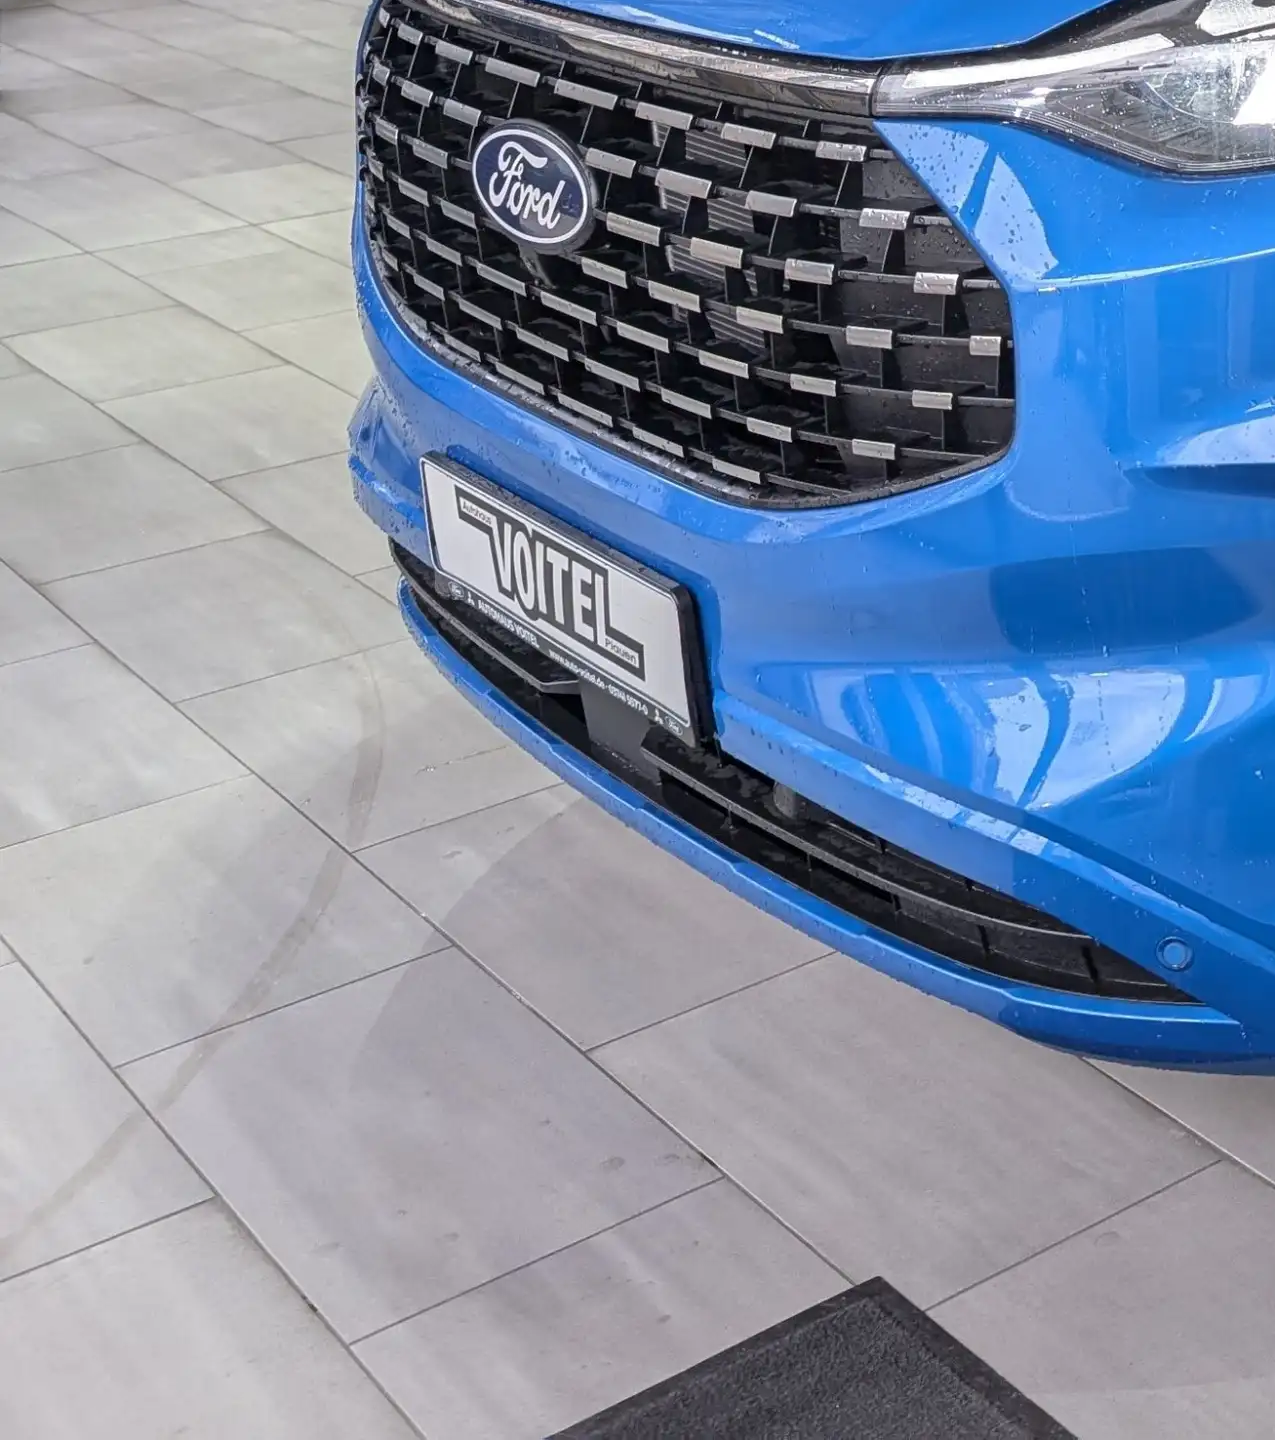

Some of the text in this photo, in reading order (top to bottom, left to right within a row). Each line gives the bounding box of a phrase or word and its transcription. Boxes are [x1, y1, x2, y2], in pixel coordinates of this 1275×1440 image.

[488, 140, 566, 230] Ford
[461, 500, 493, 525] Autohaus
[489, 514, 607, 647] VOITEL
[604, 637, 638, 665] Plauen
